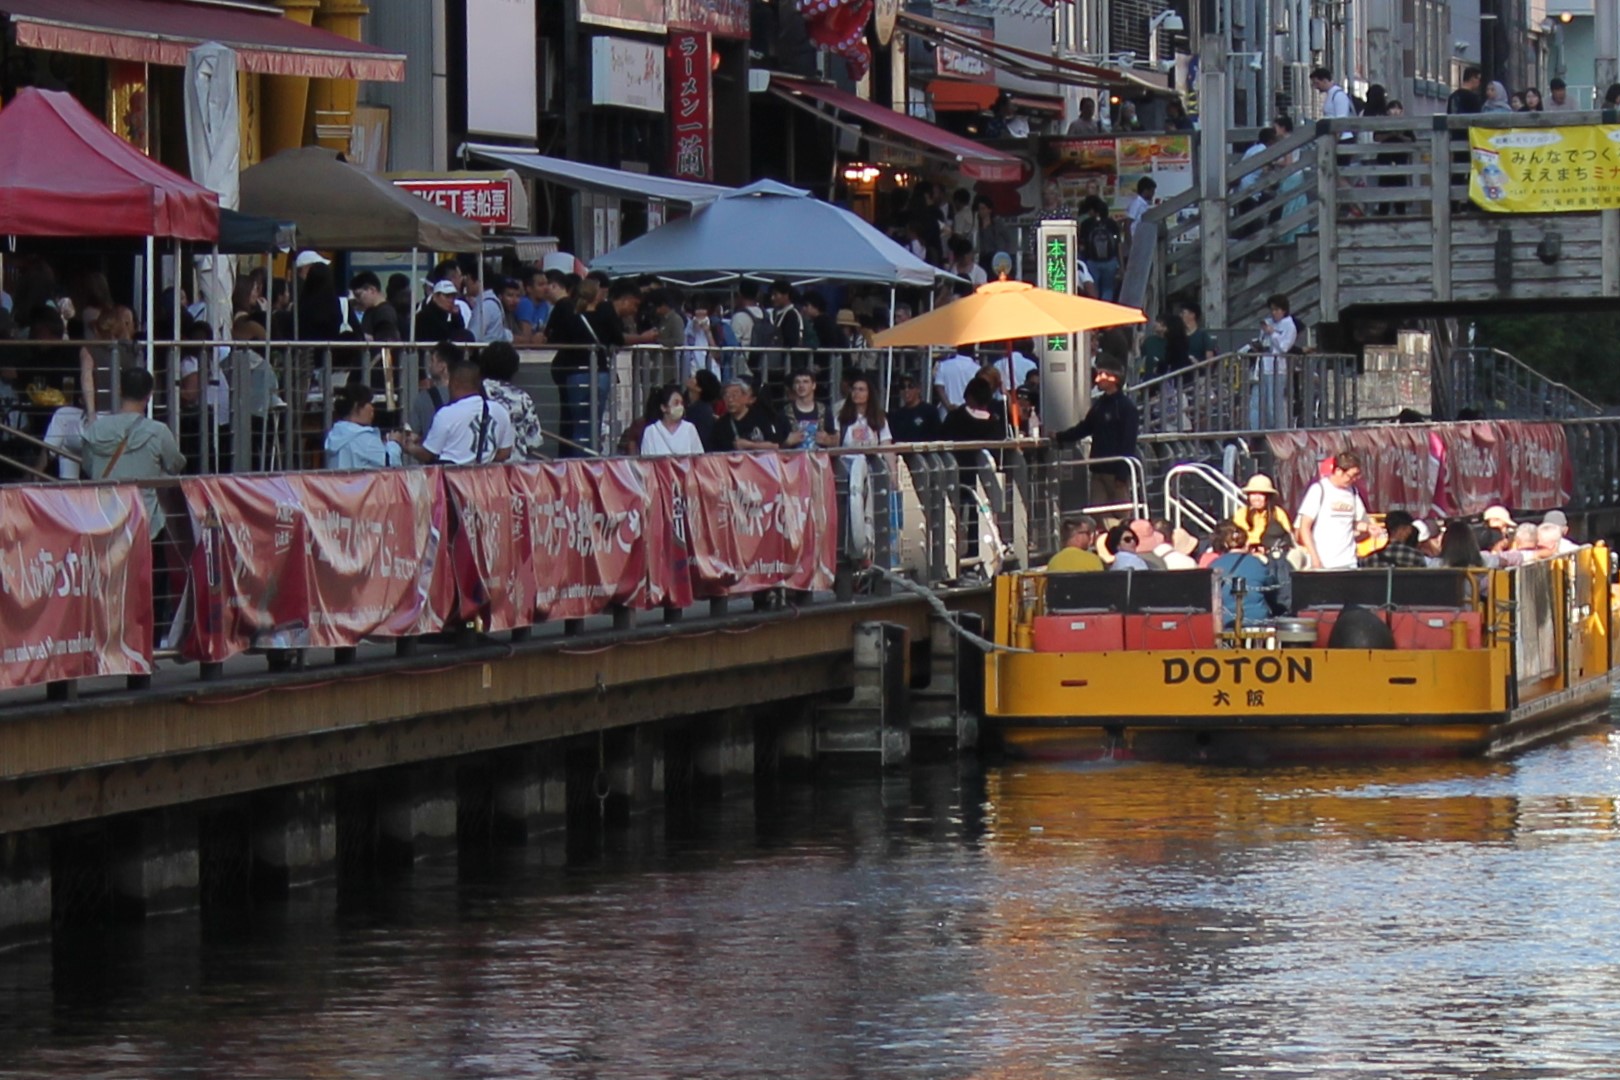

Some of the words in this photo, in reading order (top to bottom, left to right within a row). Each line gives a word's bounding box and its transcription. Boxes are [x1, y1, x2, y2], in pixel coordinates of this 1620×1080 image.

[677, 36, 706, 178] ラーメン一蘭
[462, 188, 506, 218] 乗船票
[1162, 656, 1313, 685] DOTON
[1213, 689, 1265, 707] 大阪
